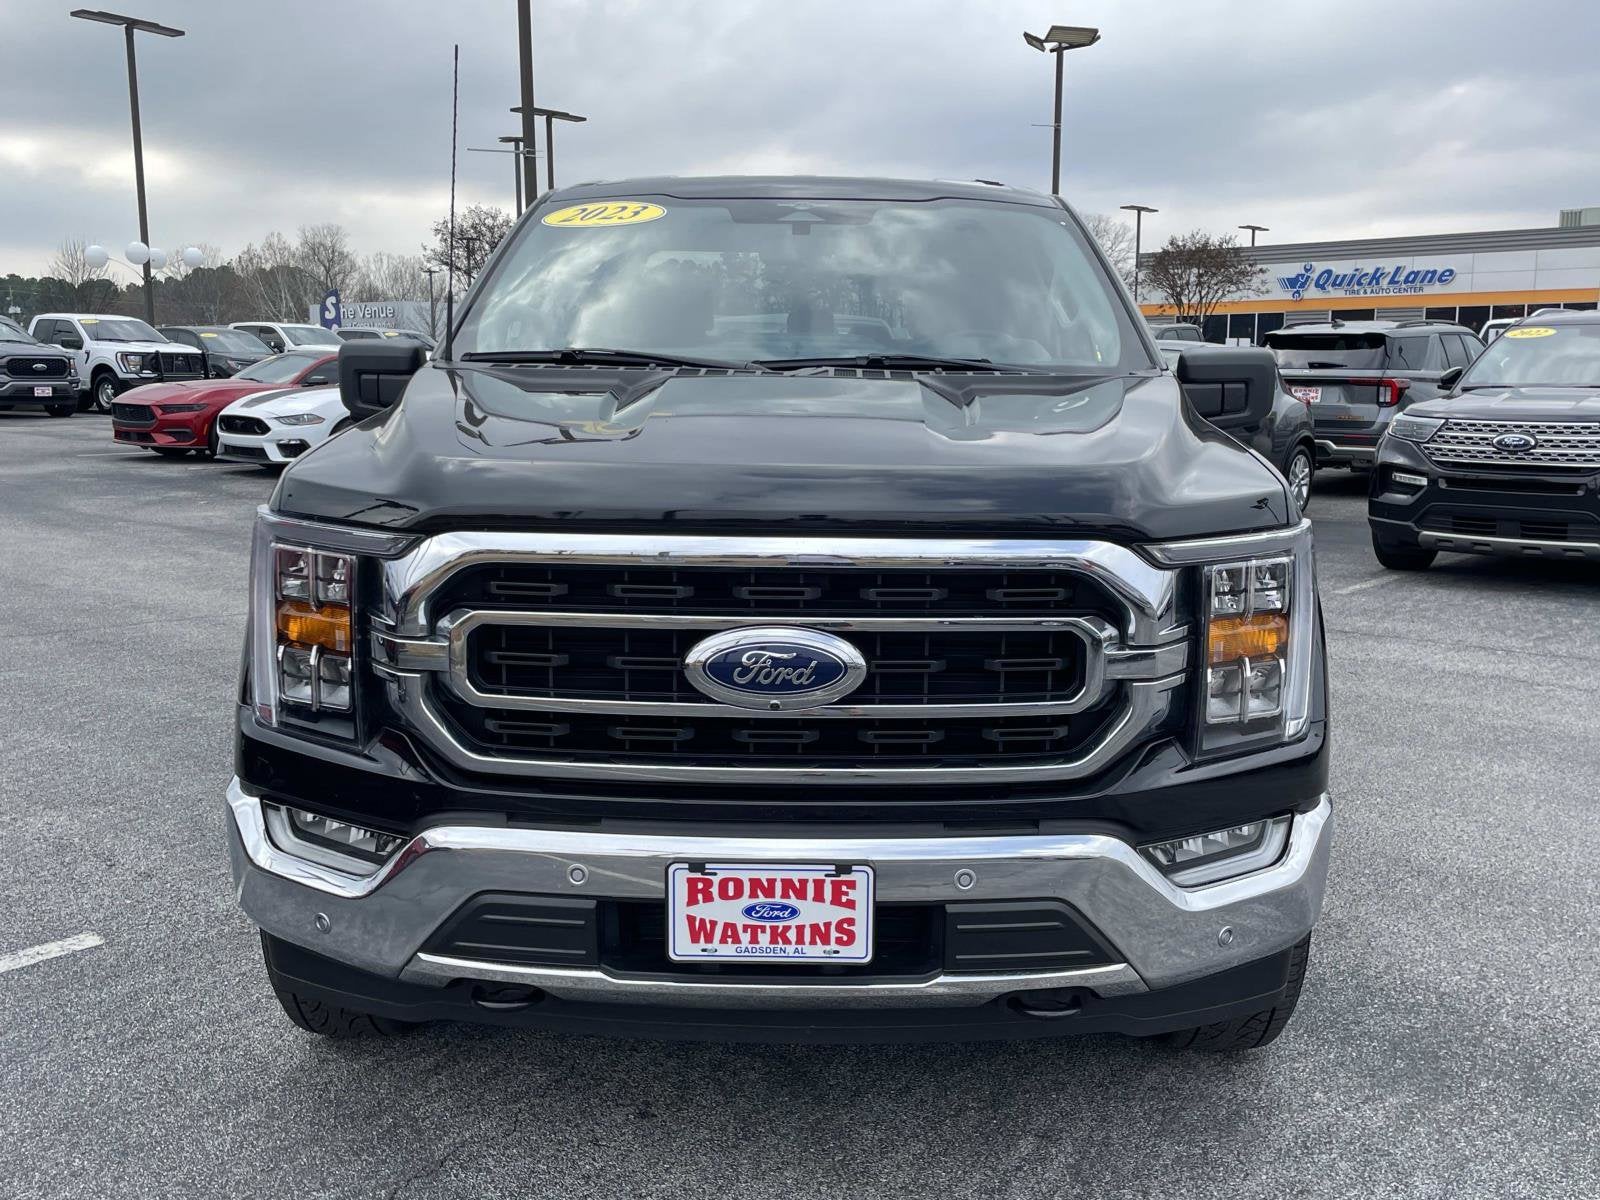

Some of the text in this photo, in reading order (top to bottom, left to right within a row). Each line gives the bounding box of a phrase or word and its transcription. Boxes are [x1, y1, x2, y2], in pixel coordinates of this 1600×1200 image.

[557, 205, 649, 223] 2023
[1314, 265, 1456, 291] Quick Lane
[1370, 287, 1392, 295] AUTO
[1393, 286, 1424, 294] CENTER
[340, 304, 395, 319] he Venue
[733, 650, 819, 686] Ford
[686, 876, 857, 911] RONNIE
[751, 903, 792, 919] Ford
[686, 913, 857, 947] WATKINS
[735, 945, 807, 956] GADSDEN, AL
